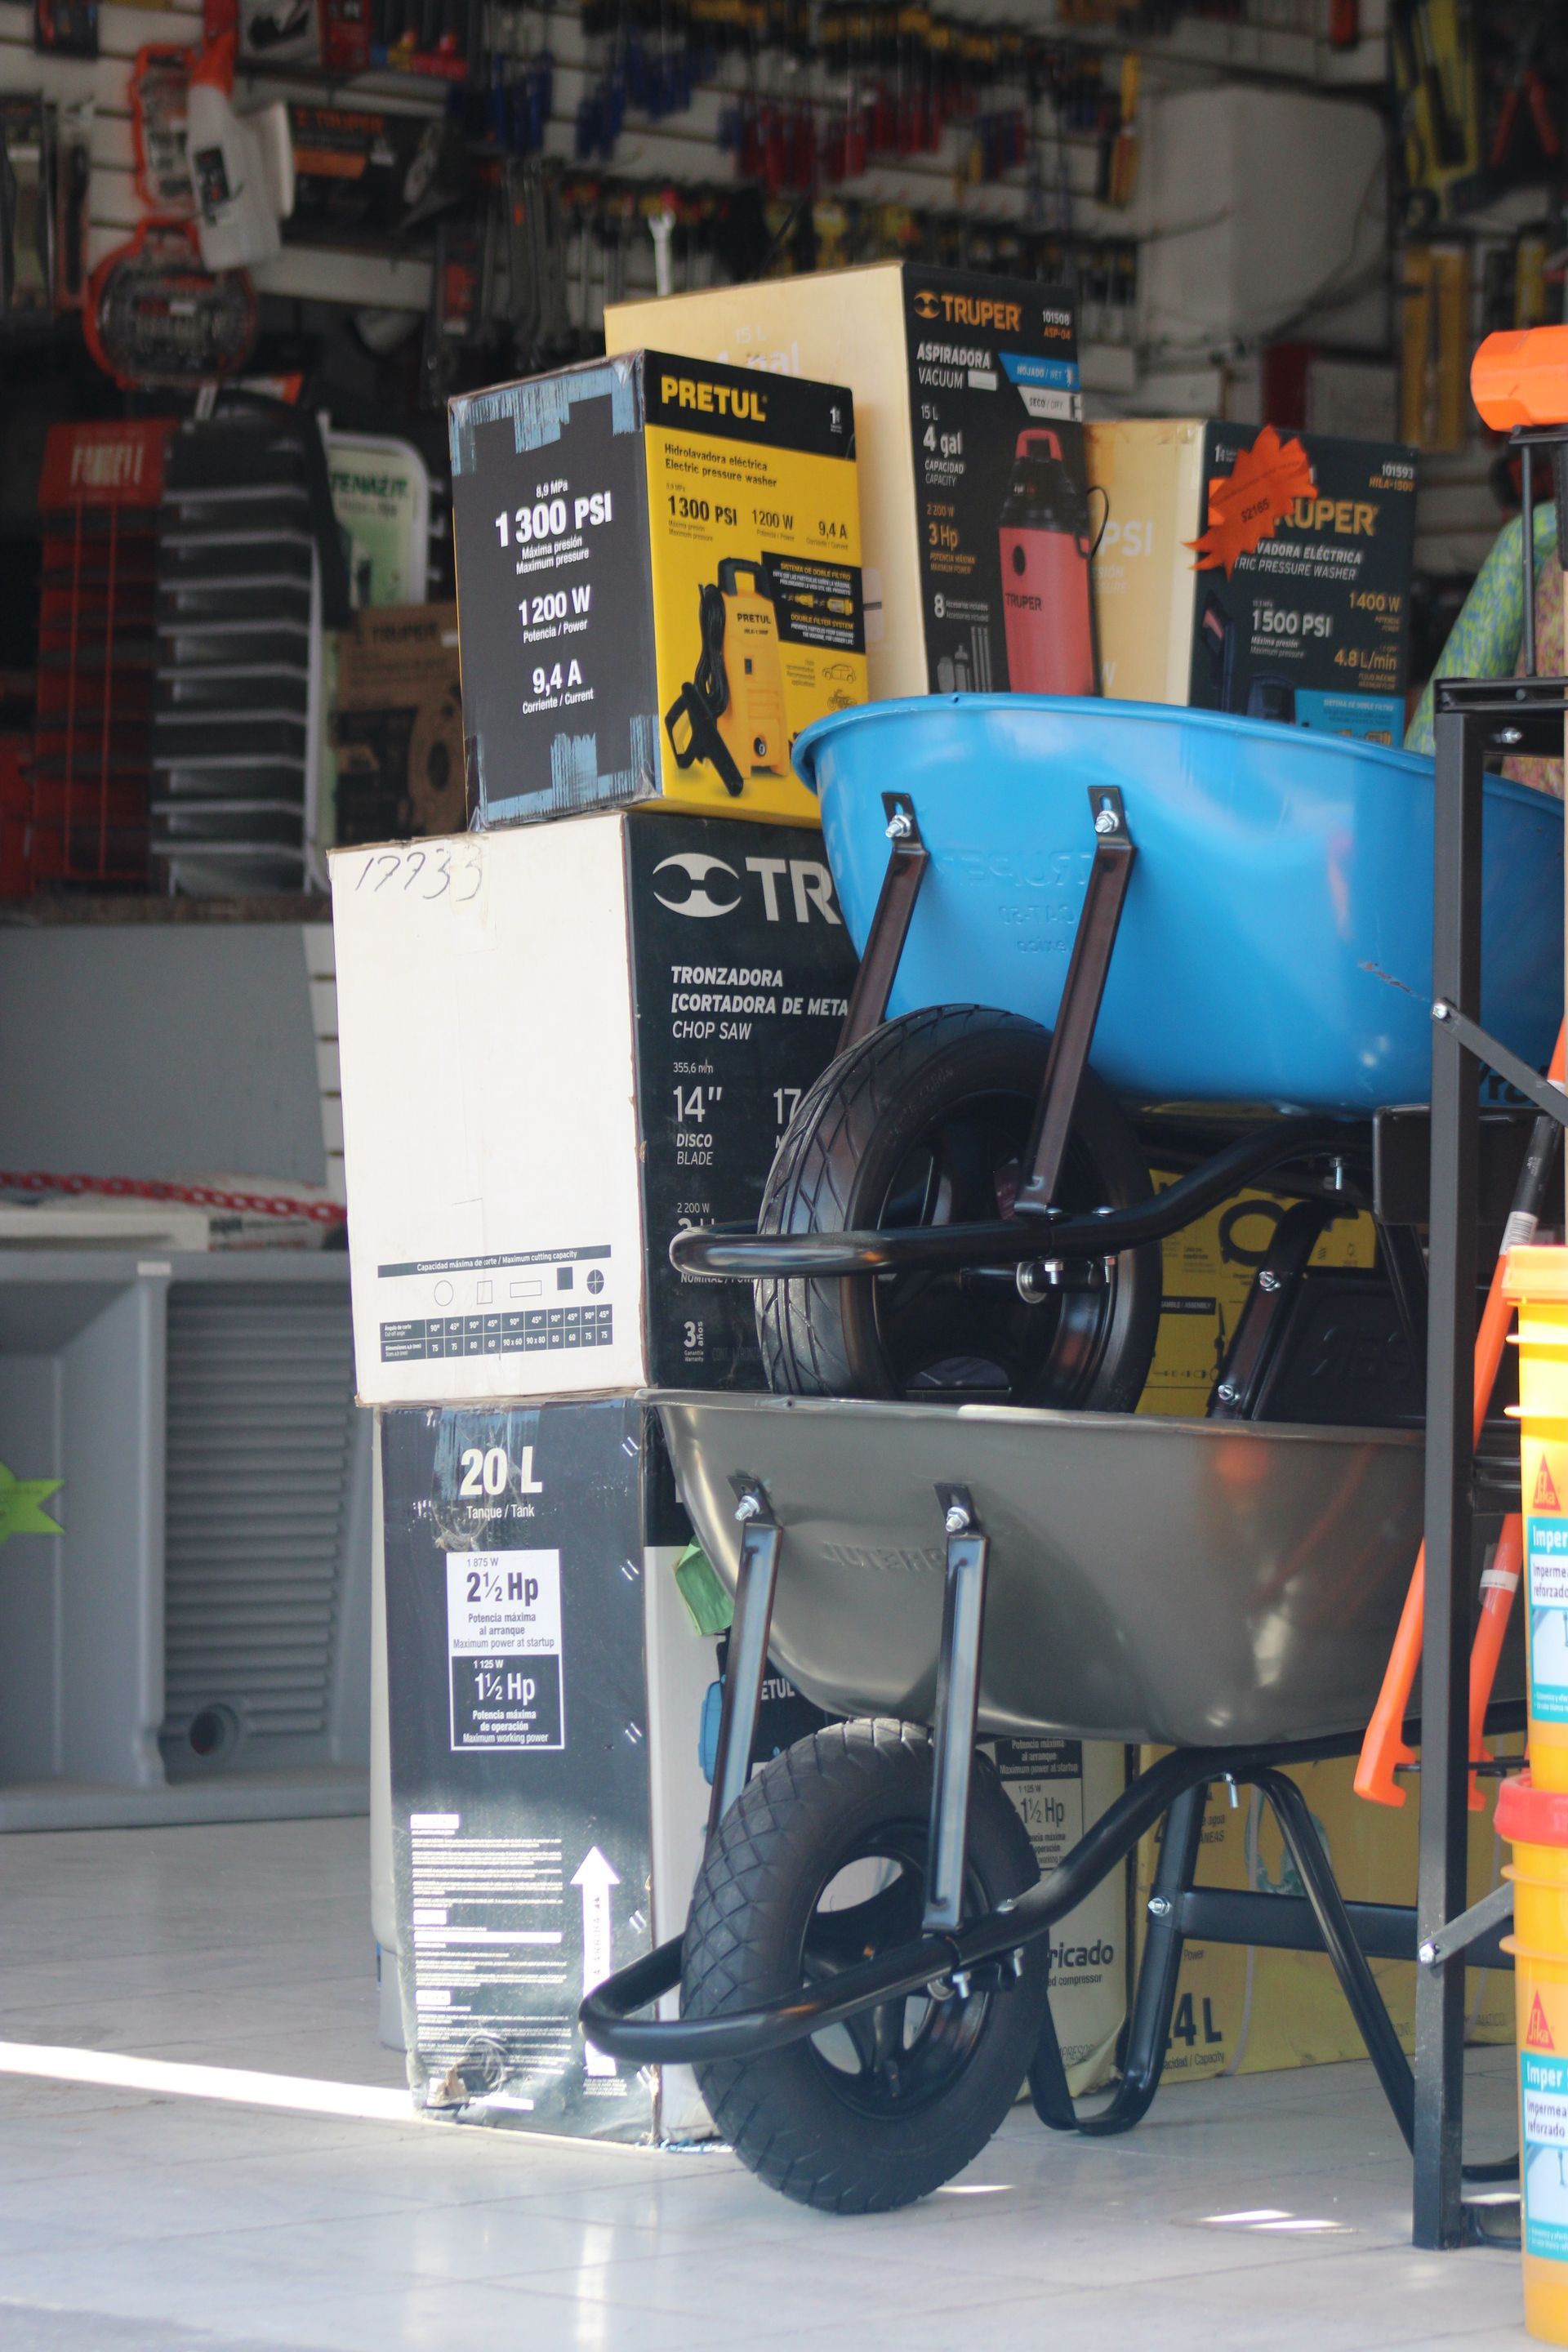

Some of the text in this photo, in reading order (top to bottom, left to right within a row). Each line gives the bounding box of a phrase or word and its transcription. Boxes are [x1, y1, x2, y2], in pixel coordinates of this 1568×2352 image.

[941, 294, 1020, 332] TRUPER
[1043, 310, 1071, 326] 101508
[1044, 327, 1071, 340] ASP-04
[917, 342, 991, 369] ASPIRADORA
[918, 368, 964, 390] VACUUM
[1017, 365, 1045, 379] MOJADO
[661, 374, 766, 422] PRETUL
[921, 405, 938, 421] 15 L
[923, 424, 962, 458] 4 gal
[665, 443, 768, 472] Hidrolavadora eléctrica
[924, 460, 964, 474] CAPACIDAD
[665, 458, 777, 488] Electric pressure washer
[925, 473, 957, 487] CAPACITY
[1382, 463, 1414, 479] 101593
[536, 478, 568, 499] 8,9 MPa
[574, 490, 612, 529] PSI
[715, 506, 737, 527] PSI
[1275, 497, 1378, 537] UPER
[782, 514, 794, 530] W
[818, 521, 848, 540] 9,4 A
[522, 533, 583, 561] Máxima presión
[929, 523, 959, 551] 3 Hp
[1100, 520, 1153, 557] PSI
[516, 548, 590, 575] Maximum pressure
[1303, 543, 1362, 564] ELÉCTRICA
[1258, 559, 1310, 576] PRESSURE
[1313, 564, 1356, 581] WASHER
[572, 584, 590, 613] W
[934, 594, 945, 618] 8
[1005, 593, 1042, 612] TRUPER
[1349, 591, 1401, 612] 1400 W
[737, 613, 771, 625] PRETUL
[1252, 610, 1333, 638] 1500 PSI
[523, 618, 588, 644] Potencia Power
[1334, 648, 1397, 670] 4.8 L/min
[532, 658, 582, 697] 9,4 A
[523, 687, 595, 715] Corriente Current
[745, 856, 842, 924] TR
[670, 965, 783, 987] TRONZADORA
[782, 997, 802, 1014] DE
[807, 999, 849, 1017] META
[672, 1020, 752, 1040] CHOP SAW
[673, 1062, 697, 1074] 355,6
[676, 1134, 713, 1148] DISCO
[676, 1151, 714, 1165] BLADE
[701, 1203, 710, 1214] W
[416, 1250, 577, 1272] Capacidad máxima de corte Maximum cutting capacity
[451, 1343, 457, 1351] 75
[585, 1332, 592, 1340] 75
[684, 1321, 696, 1348] 3
[460, 1446, 543, 1496] 20 L
[466, 1503, 535, 1521] Tanque Tank
[1533, 1525, 1568, 1552] Imper
[490, 1557, 499, 1566] W
[507, 1572, 539, 1606] Hp
[468, 1611, 536, 1623] Potencia máxima
[479, 1625, 525, 1637] al arranque
[452, 1637, 555, 1651] Maximum power at startup
[494, 1659, 504, 1668] W
[507, 1673, 536, 1705] Hp
[761, 1678, 795, 1699] ETUL
[473, 1709, 537, 1721] Potencia máxima
[480, 1721, 529, 1733] de operación
[463, 1732, 549, 1745] Maximum working power
[1045, 1797, 1065, 1827] Hp
[1184, 1949, 1205, 1961] Power
[1058, 1974, 1102, 1987] compressor
[1202, 1997, 1223, 2044] L
[1194, 2051, 1225, 2066] Capacity
[1526, 2060, 1563, 2091] Imper
[1528, 2118, 1566, 2140] reforzado
